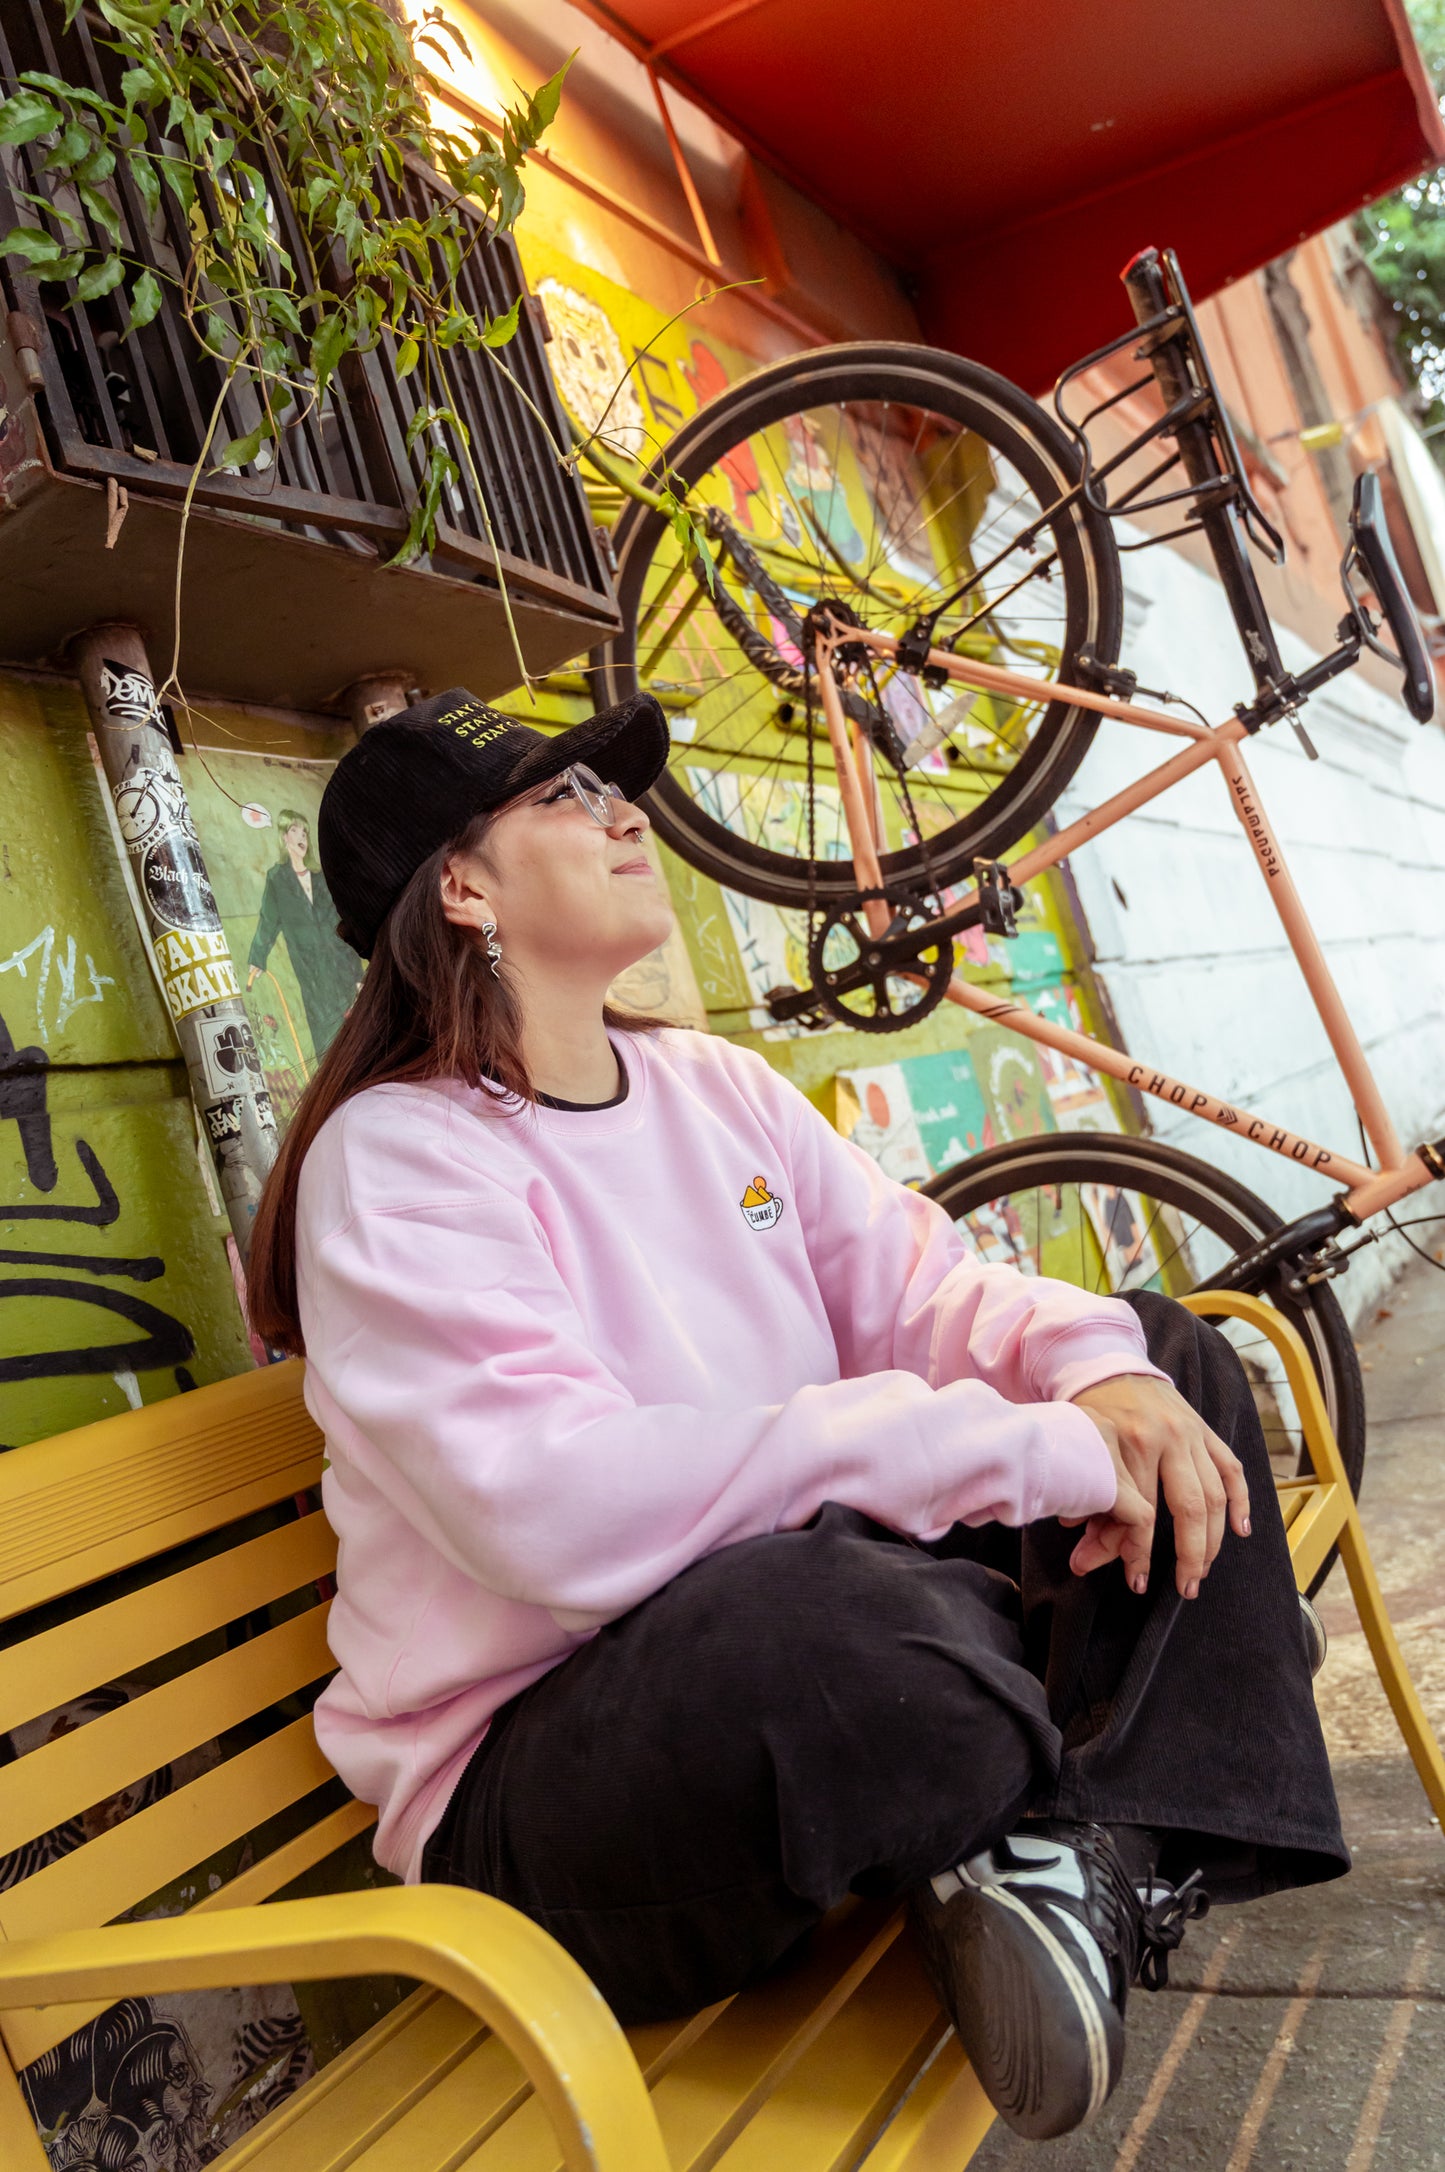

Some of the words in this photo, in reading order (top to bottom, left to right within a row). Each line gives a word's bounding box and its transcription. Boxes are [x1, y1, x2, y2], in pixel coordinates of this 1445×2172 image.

[438, 704, 474, 725] STAY
[455, 714, 491, 737] STAY
[472, 724, 509, 748] STAY
[149, 865, 188, 886] Black
[1128, 1066, 1208, 1111] CHOP
[1247, 1120, 1332, 1168] CHOP
